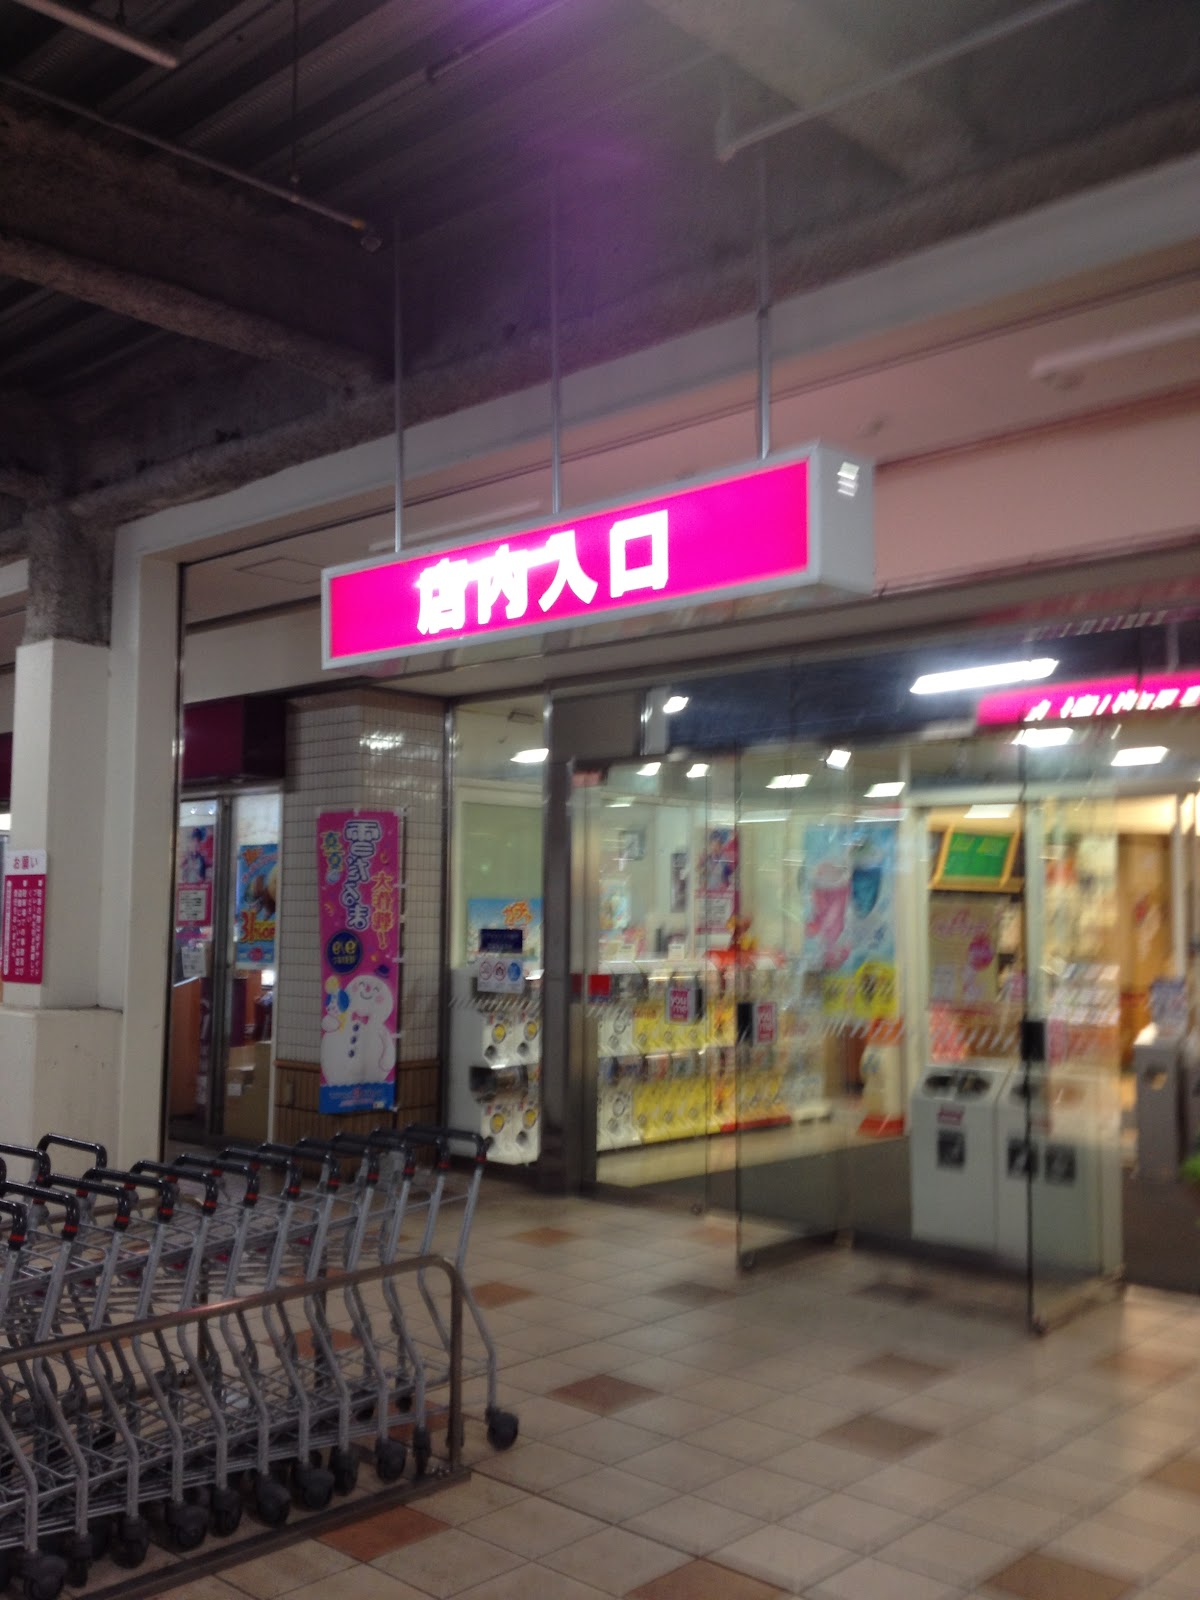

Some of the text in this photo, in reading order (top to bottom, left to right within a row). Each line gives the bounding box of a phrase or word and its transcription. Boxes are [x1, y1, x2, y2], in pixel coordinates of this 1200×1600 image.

[417, 510, 669, 635] 店内入口
[13, 855, 38, 870] お願い
[341, 820, 381, 931] 雪だるま
